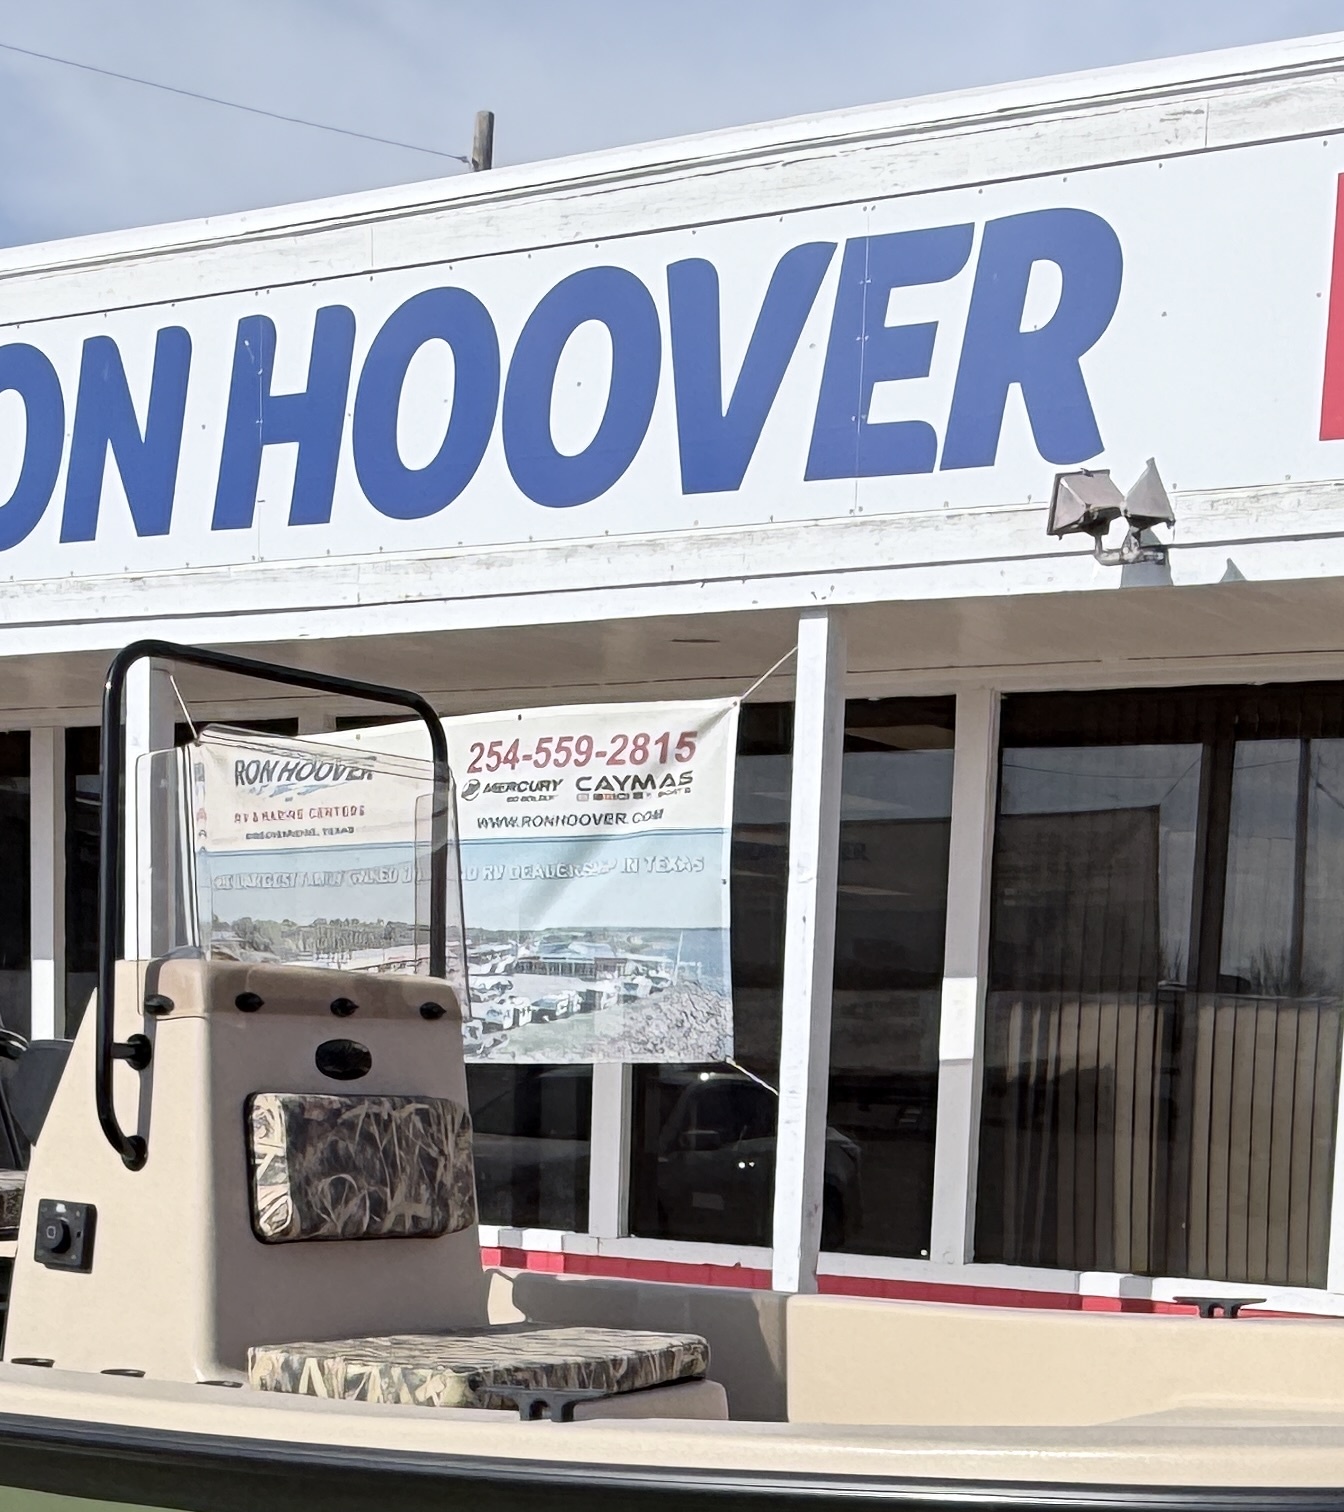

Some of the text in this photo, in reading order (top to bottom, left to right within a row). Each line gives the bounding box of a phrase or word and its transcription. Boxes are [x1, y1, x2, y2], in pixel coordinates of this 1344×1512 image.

[211, 206, 1123, 532] HOOVER
[467, 731, 698, 774] 254-559-2815
[234, 759, 280, 787] RON
[483, 778, 564, 793] MERCURY
[575, 770, 694, 791] CAYMAS
